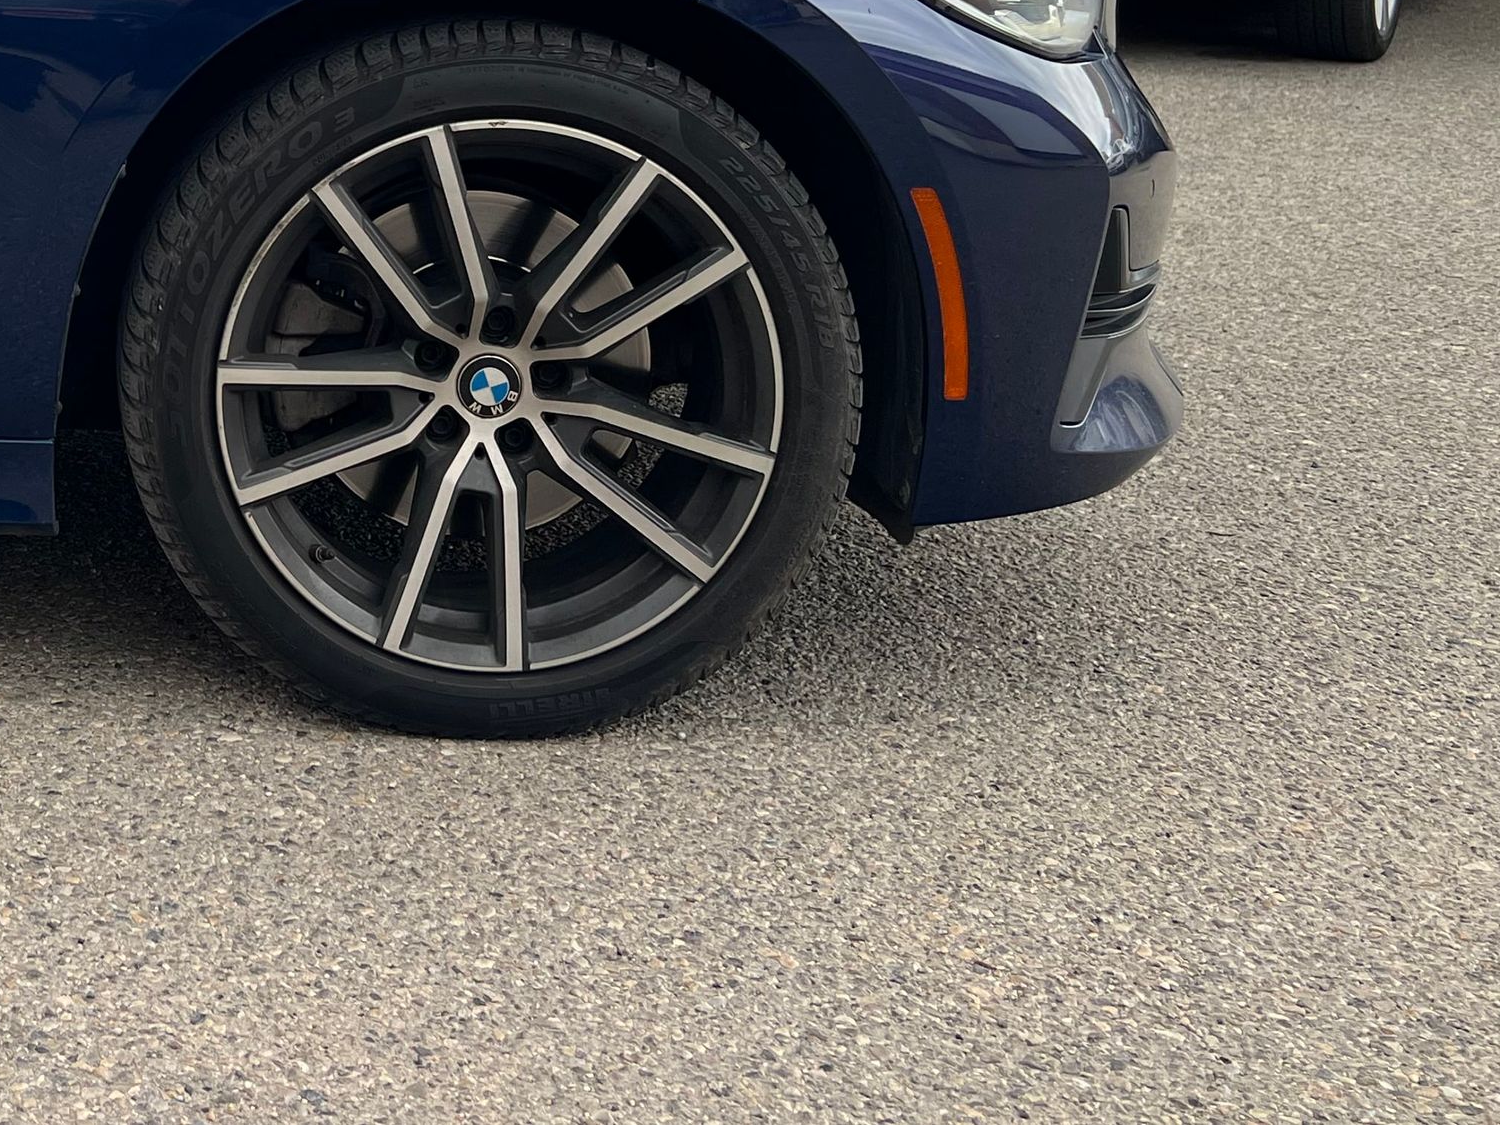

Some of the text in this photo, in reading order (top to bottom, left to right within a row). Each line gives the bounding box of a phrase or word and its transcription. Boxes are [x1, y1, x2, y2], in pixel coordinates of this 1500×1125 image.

[332, 106, 356, 133] 3
[717, 156, 811, 273] 225/45
[803, 282, 836, 350] R18
[468, 390, 519, 416] BMW
